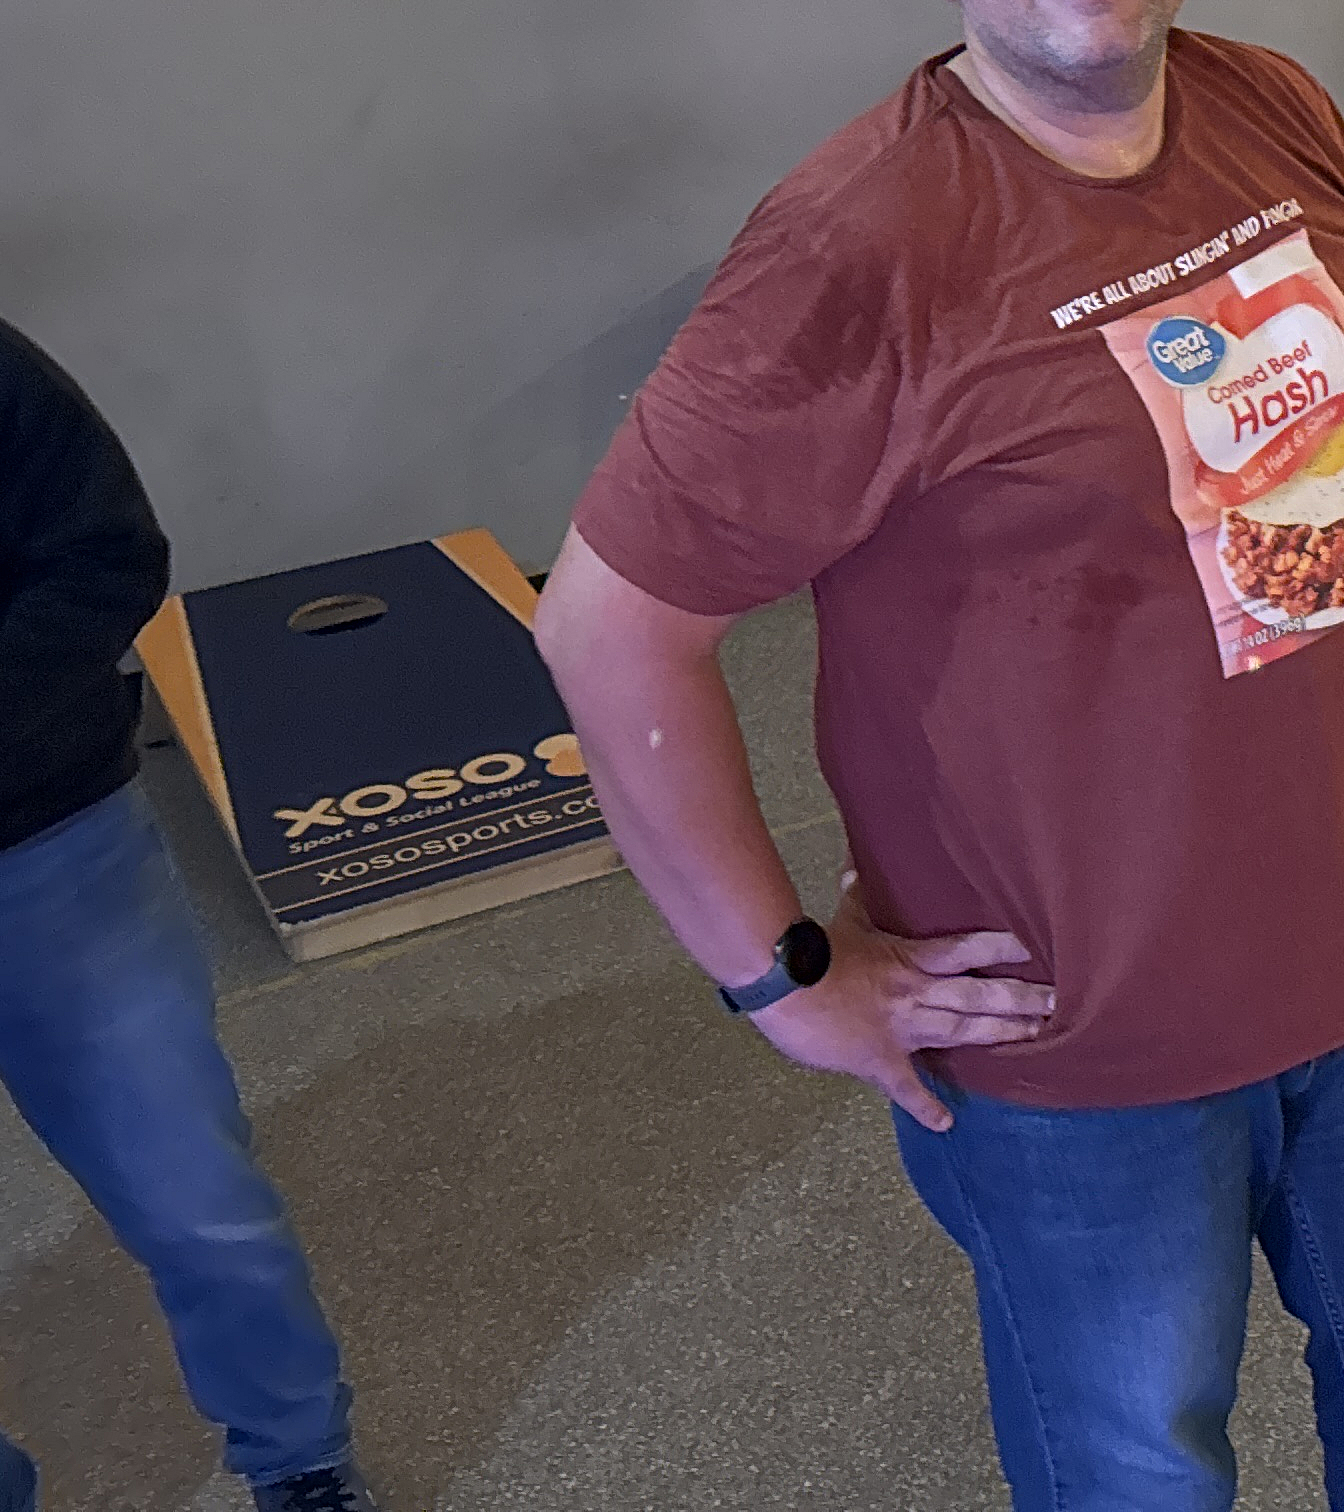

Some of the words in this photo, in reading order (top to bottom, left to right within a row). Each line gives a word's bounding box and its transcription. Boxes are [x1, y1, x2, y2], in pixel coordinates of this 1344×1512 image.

[1050, 292, 1106, 329] WE'RE
[1102, 281, 1131, 305] ALL
[1127, 263, 1176, 295] ABOUT
[1230, 216, 1260, 246] AND
[1152, 326, 1211, 364] Great
[1207, 364, 1269, 404] Corned
[1266, 339, 1312, 375] Beef
[1228, 366, 1329, 444] Hash
[273, 753, 527, 838] XOSO
[288, 829, 356, 854] Sport
[361, 822, 380, 834] &
[384, 801, 453, 828] Social
[458, 779, 542, 807] League
[315, 795, 600, 887] xososports.co
